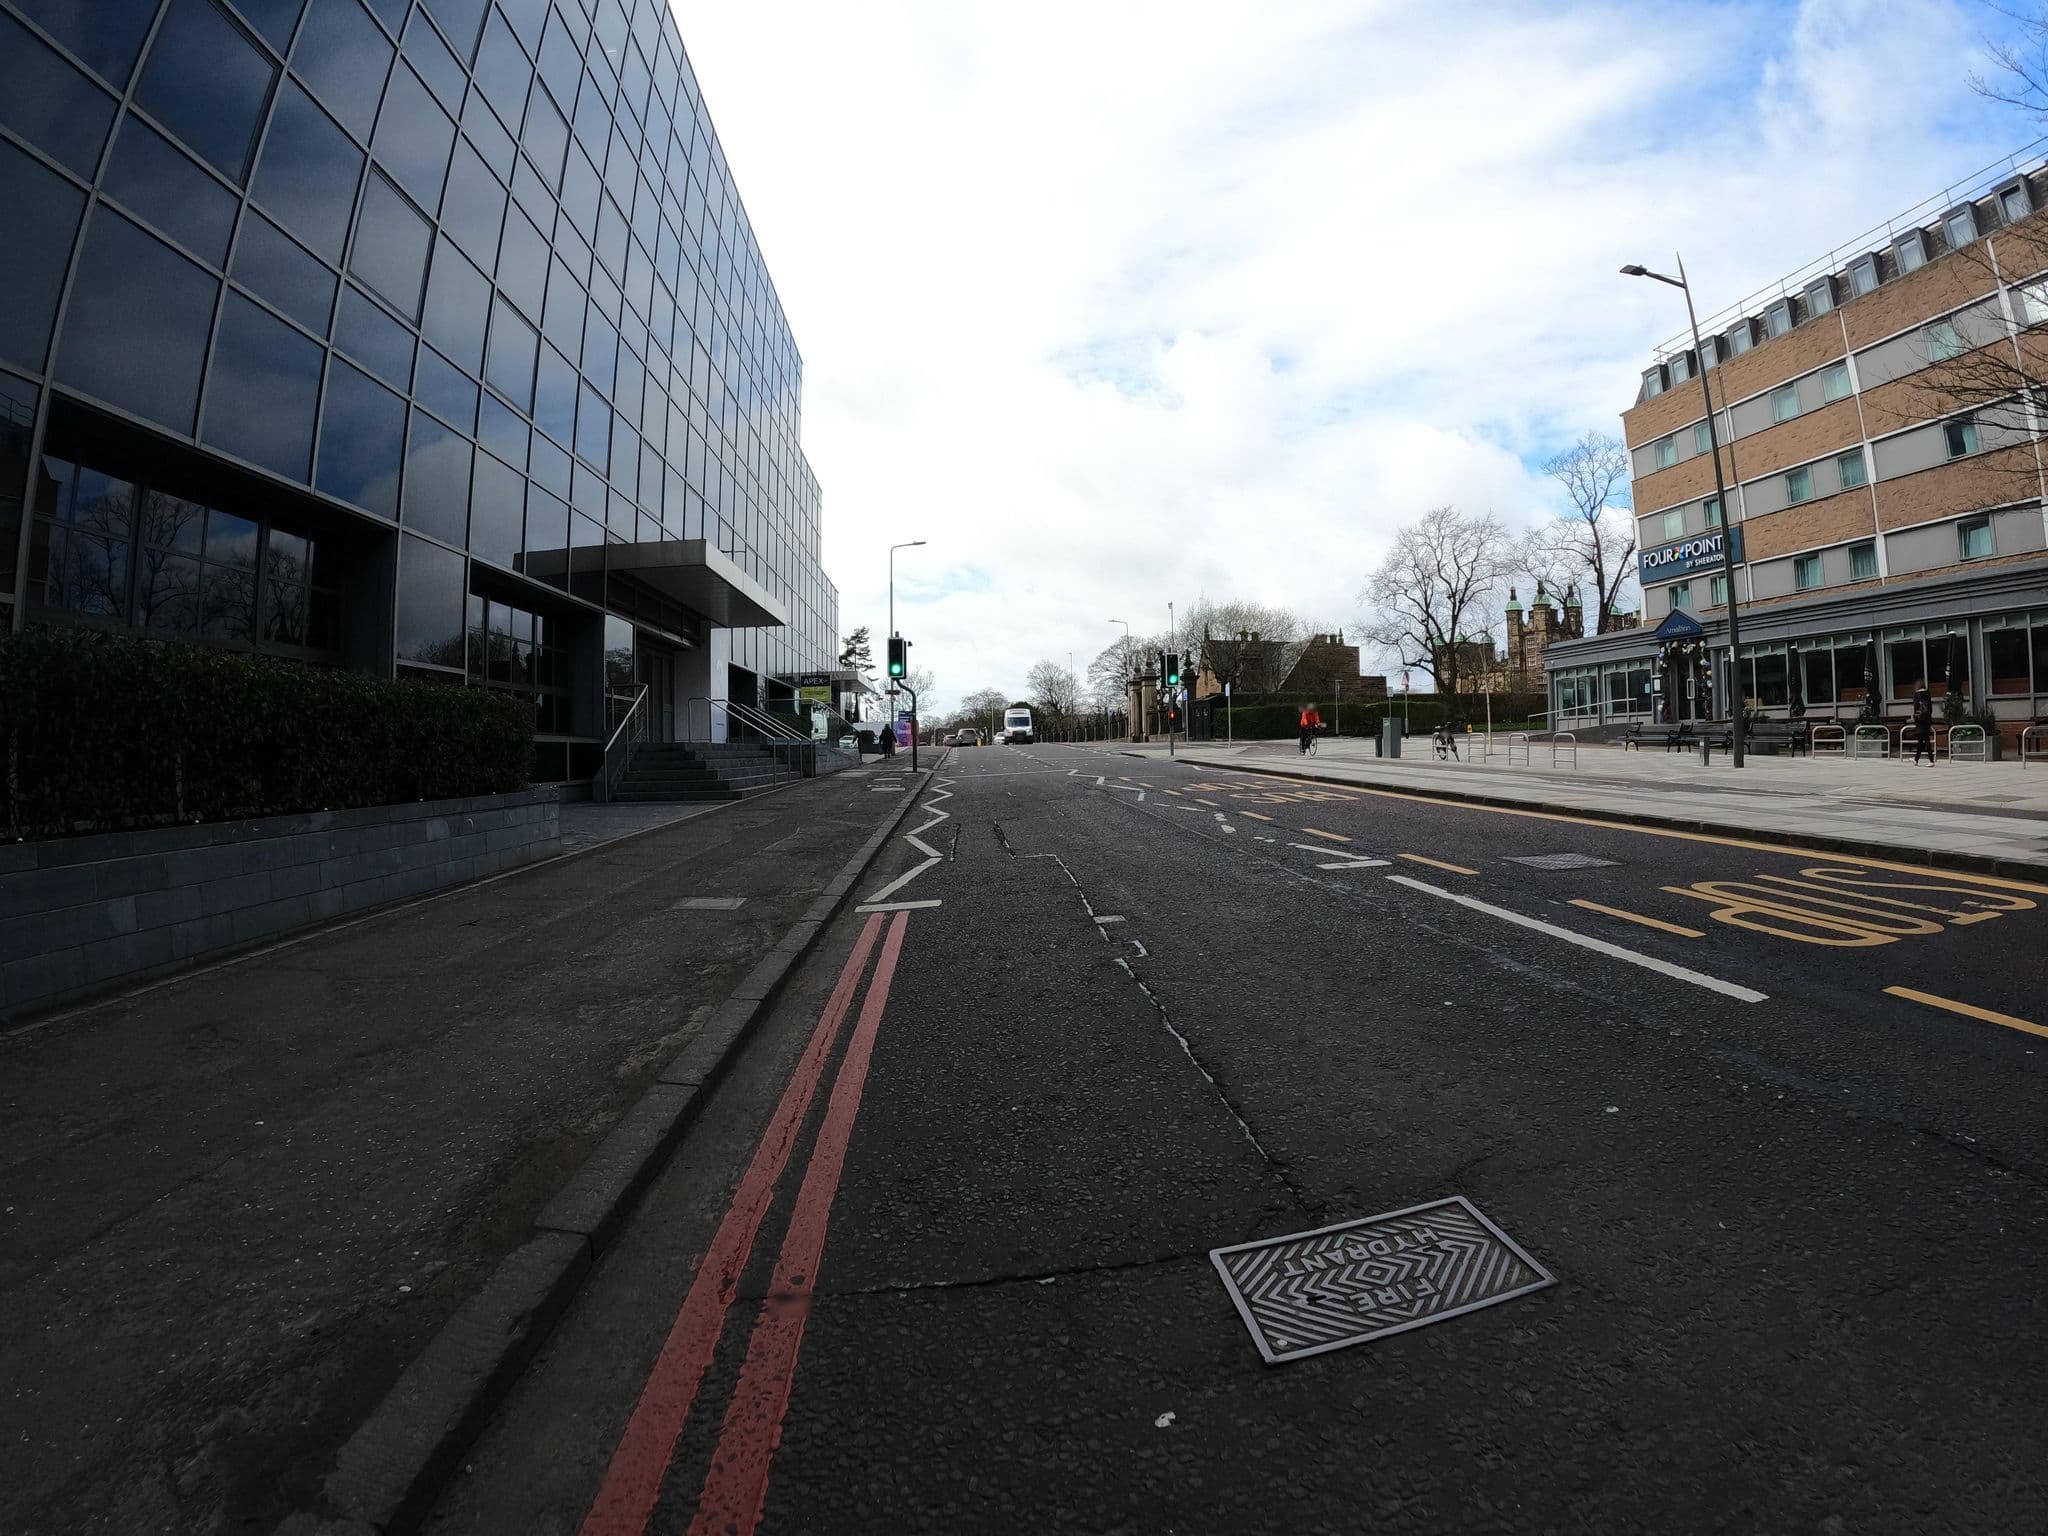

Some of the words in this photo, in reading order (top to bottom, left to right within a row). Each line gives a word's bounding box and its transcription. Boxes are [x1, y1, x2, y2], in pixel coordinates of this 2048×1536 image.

[1643, 549, 1674, 568] FOUR
[1686, 560, 1694, 569] BY
[803, 677, 825, 685] APEX
[1283, 1227, 1440, 1278] HYDRANT
[1349, 1277, 1437, 1312] FIRE
